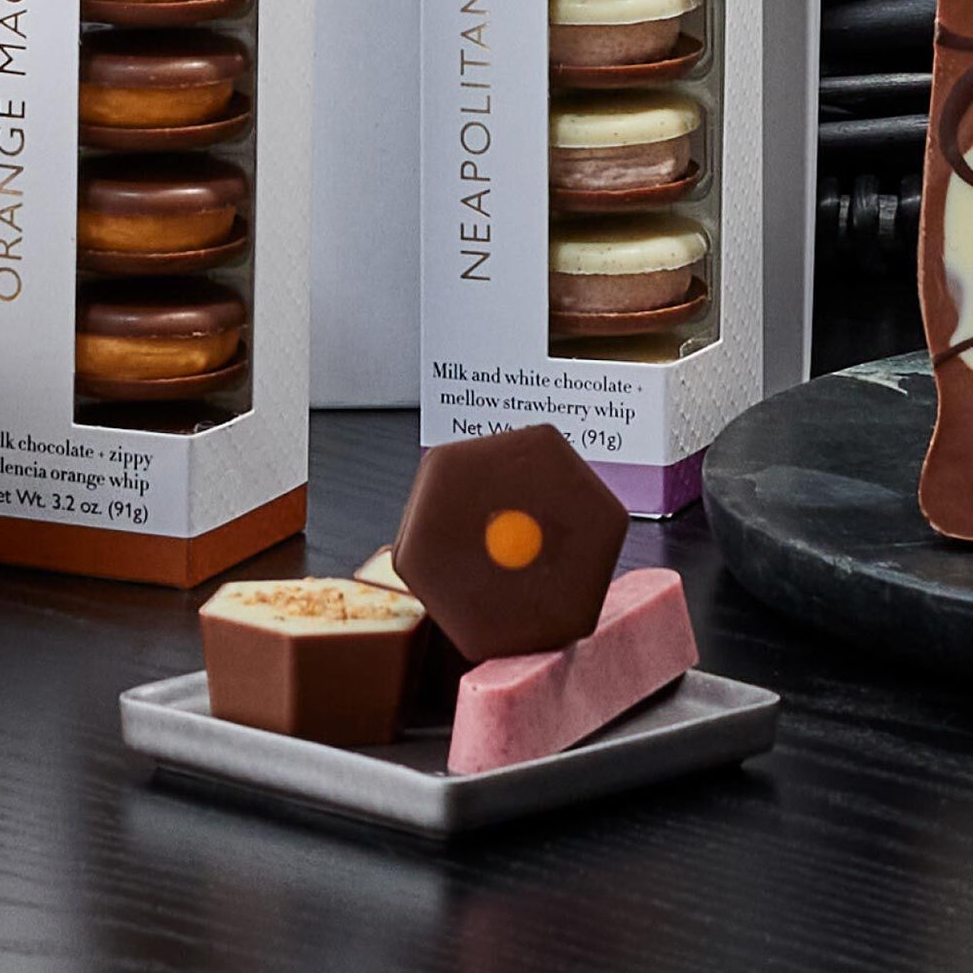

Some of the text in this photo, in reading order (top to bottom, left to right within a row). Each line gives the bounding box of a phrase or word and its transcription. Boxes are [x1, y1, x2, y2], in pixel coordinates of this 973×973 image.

[433, 361, 468, 381] Milk
[472, 367, 501, 383] and
[505, 369, 550, 387] white
[554, 373, 632, 393] chocolate
[440, 389, 636, 425] mellow strawberry whip
[453, 418, 482, 436] Net
[581, 429, 622, 451] (91g)
[18, 434, 94, 458] chocolate
[109, 446, 153, 471] zippy
[50, 468, 105, 491] orange
[109, 472, 150, 497] whip
[16, 489, 45, 508] Wt.
[51, 493, 75, 512] 3.2
[80, 502, 102, 515] oz.
[108, 500, 149, 524] (91g)
